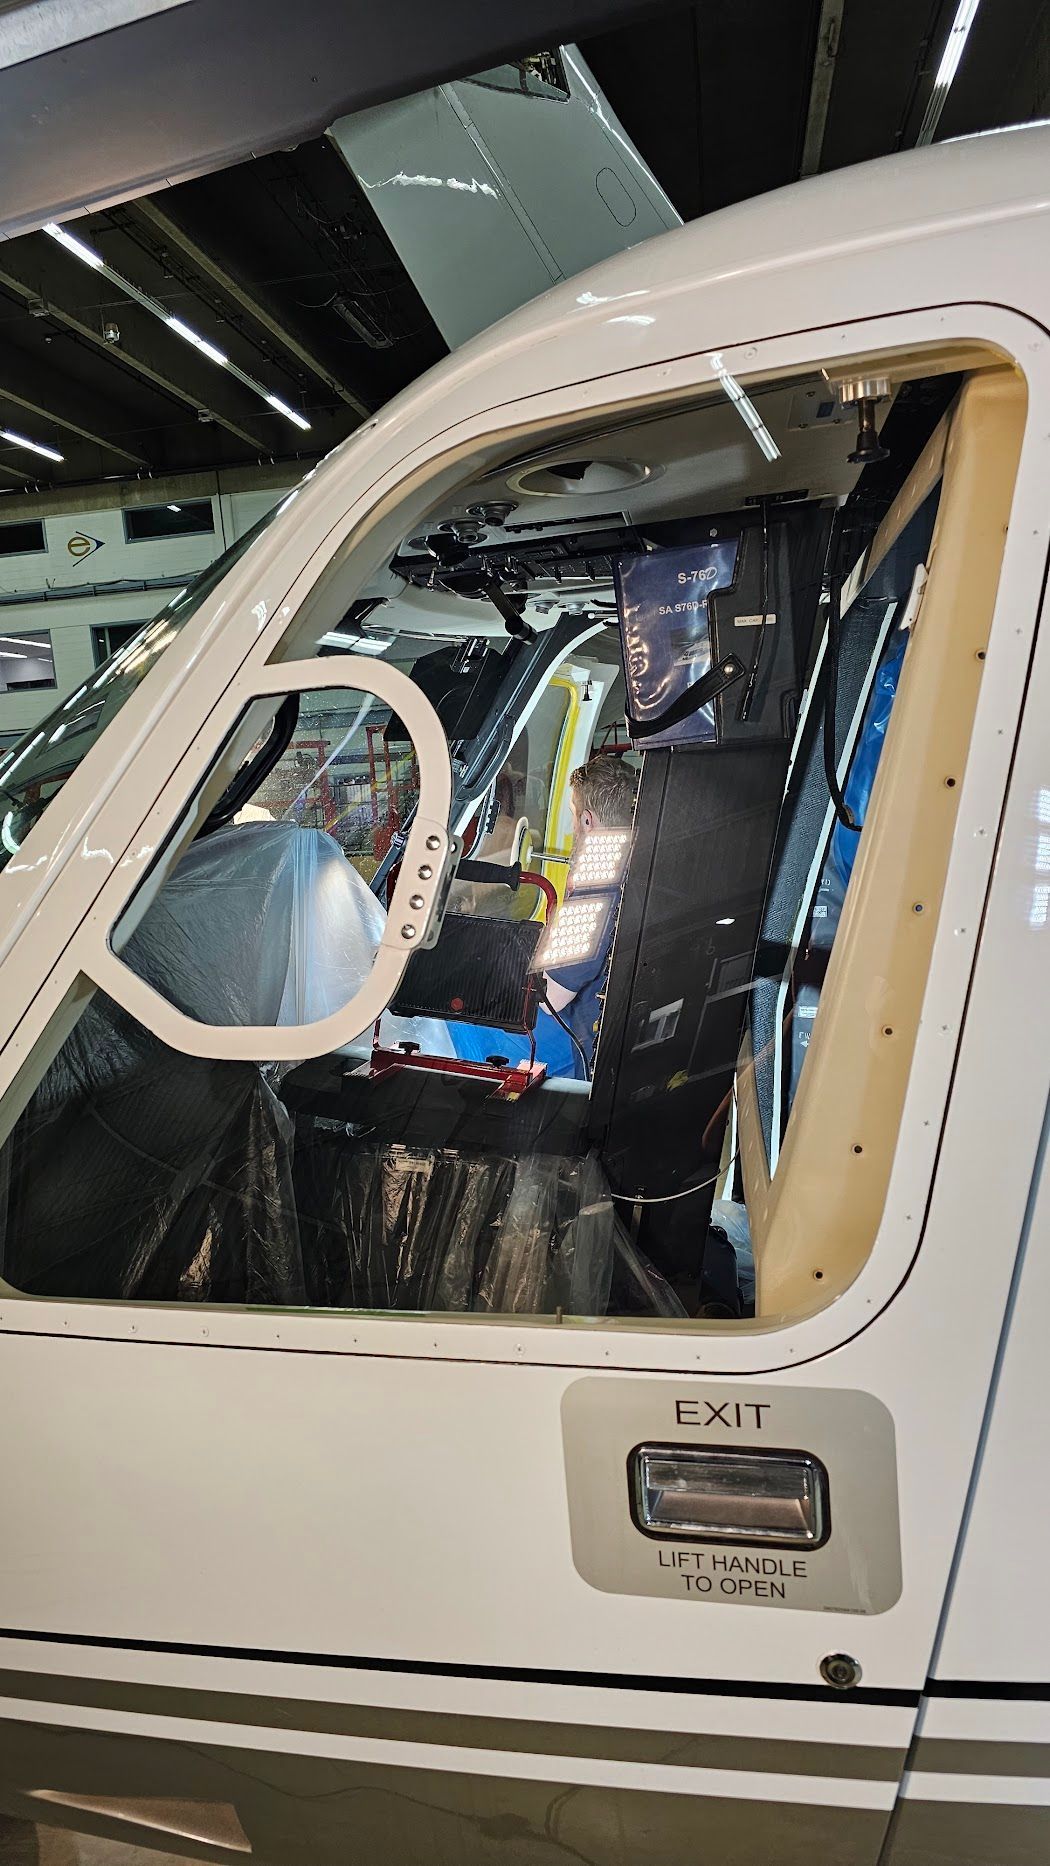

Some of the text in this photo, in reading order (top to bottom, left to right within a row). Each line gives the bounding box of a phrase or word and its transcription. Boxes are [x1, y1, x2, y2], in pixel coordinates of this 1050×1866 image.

[658, 605, 673, 615] SA
[675, 1400, 771, 1429] EXIT
[658, 1550, 808, 1578] LIFT HANDLE
[681, 1574, 786, 1599] TO OPEN
